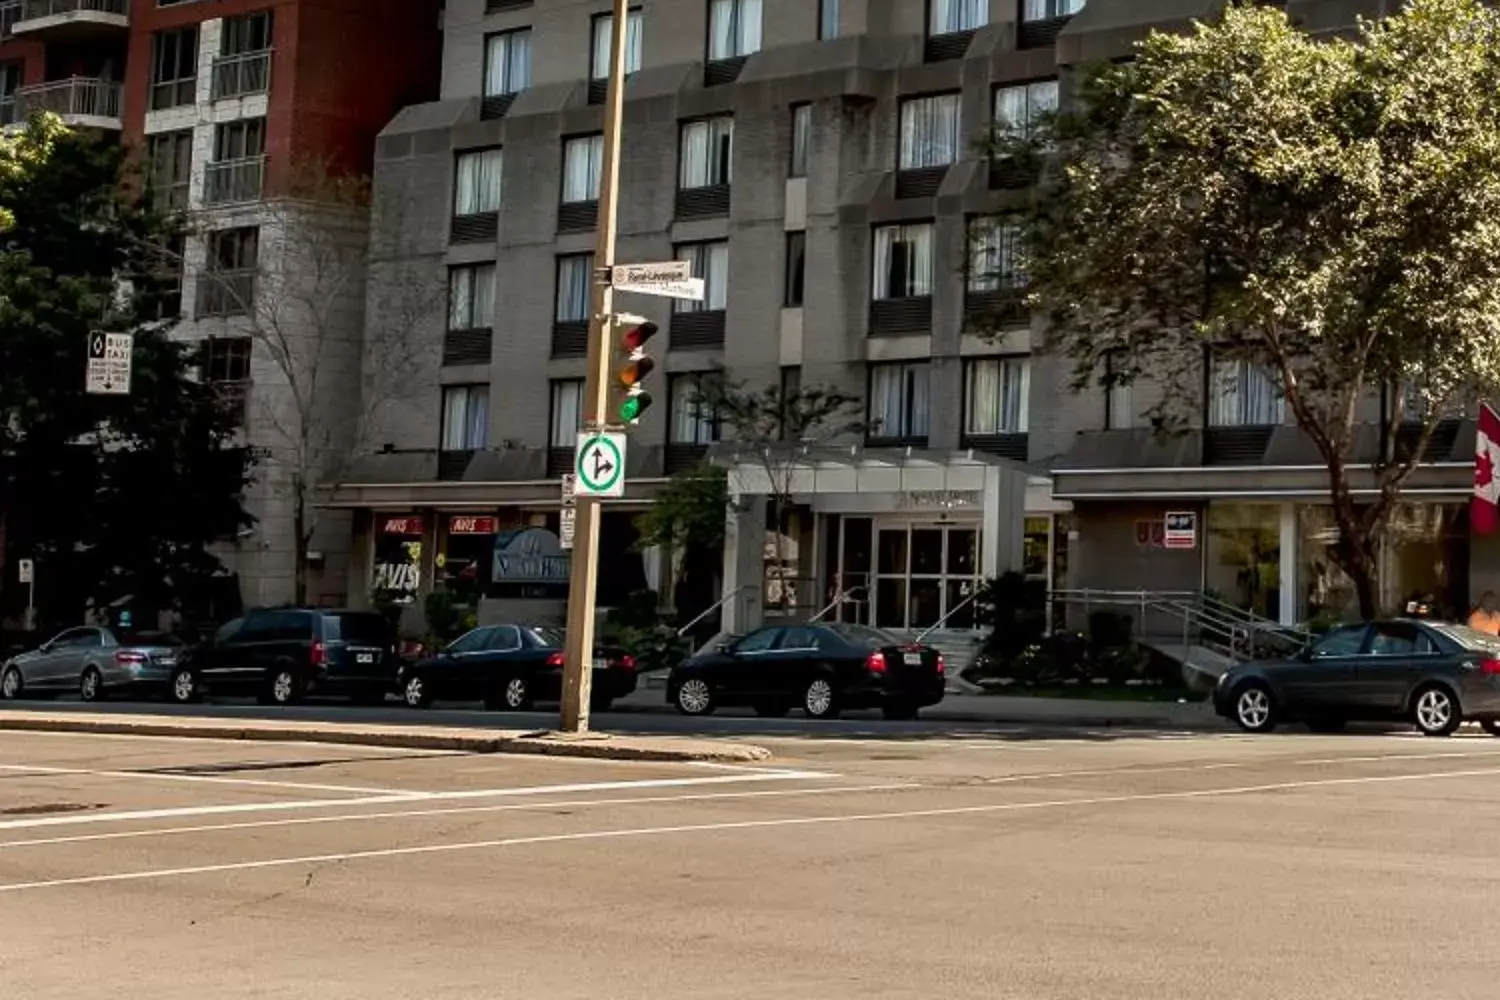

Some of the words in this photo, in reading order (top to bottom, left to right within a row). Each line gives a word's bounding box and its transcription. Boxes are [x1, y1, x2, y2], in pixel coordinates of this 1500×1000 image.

[107, 337, 129, 349] BUS
[107, 349, 129, 360] TAXI
[384, 519, 408, 534] AVIS
[452, 519, 478, 533] AVIS
[374, 562, 417, 591] AVIS
